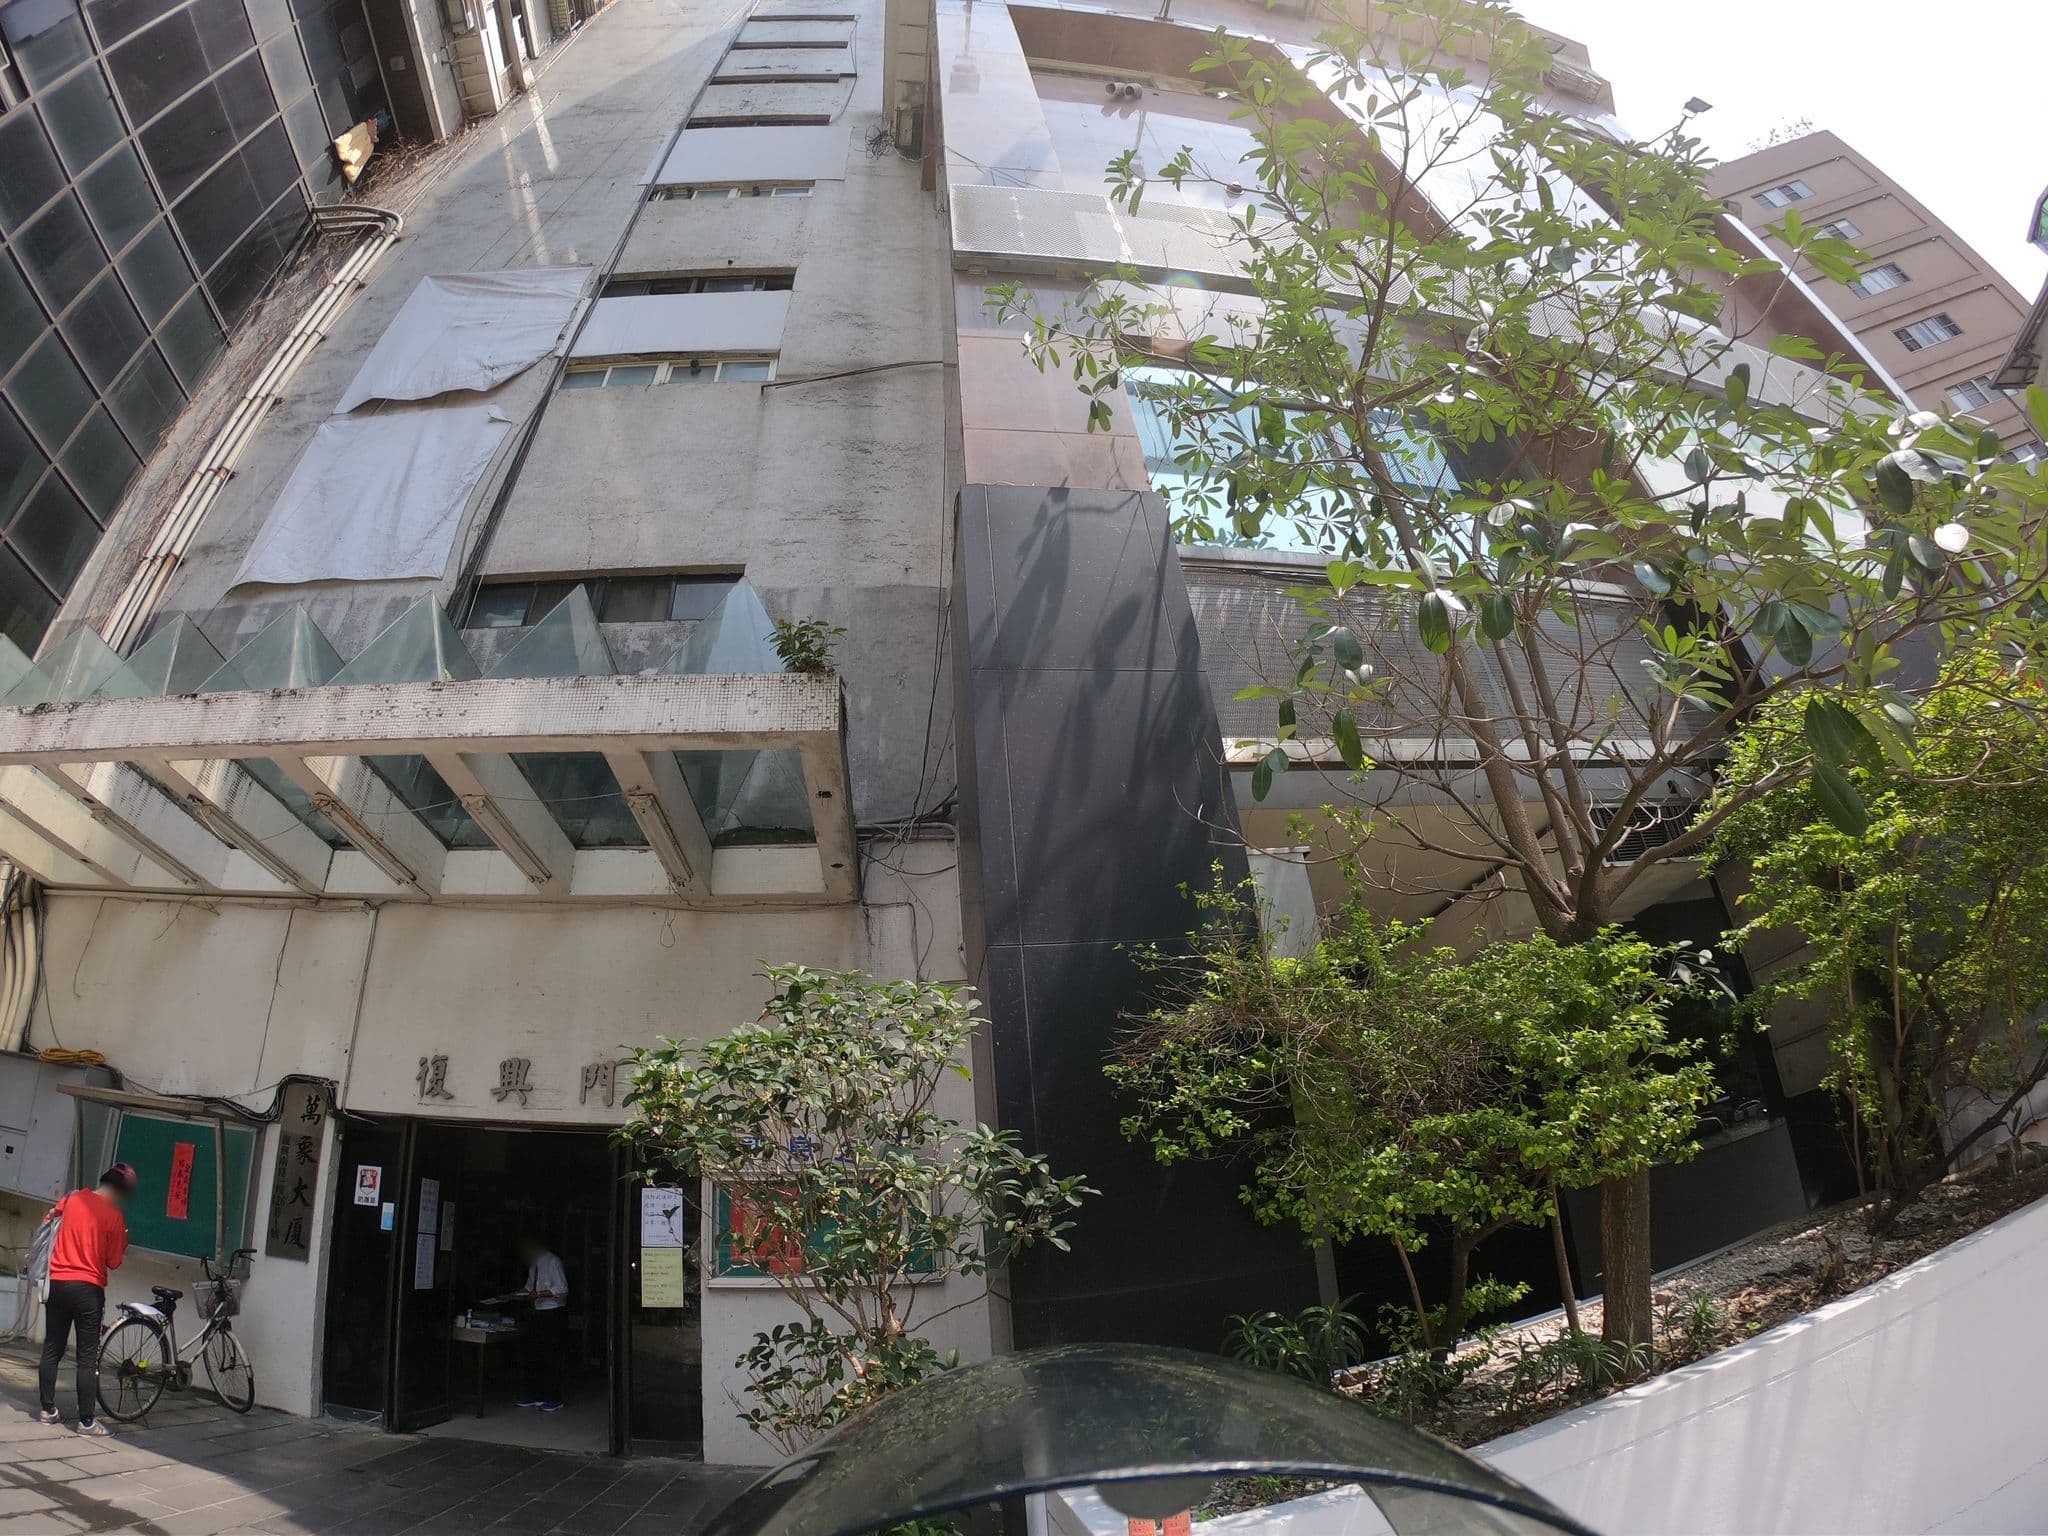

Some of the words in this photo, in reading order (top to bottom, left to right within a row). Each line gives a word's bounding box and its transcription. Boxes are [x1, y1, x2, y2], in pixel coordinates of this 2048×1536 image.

[416, 1054, 617, 1107] 復興門
[283, 1094, 322, 1250] 萬象大廈
